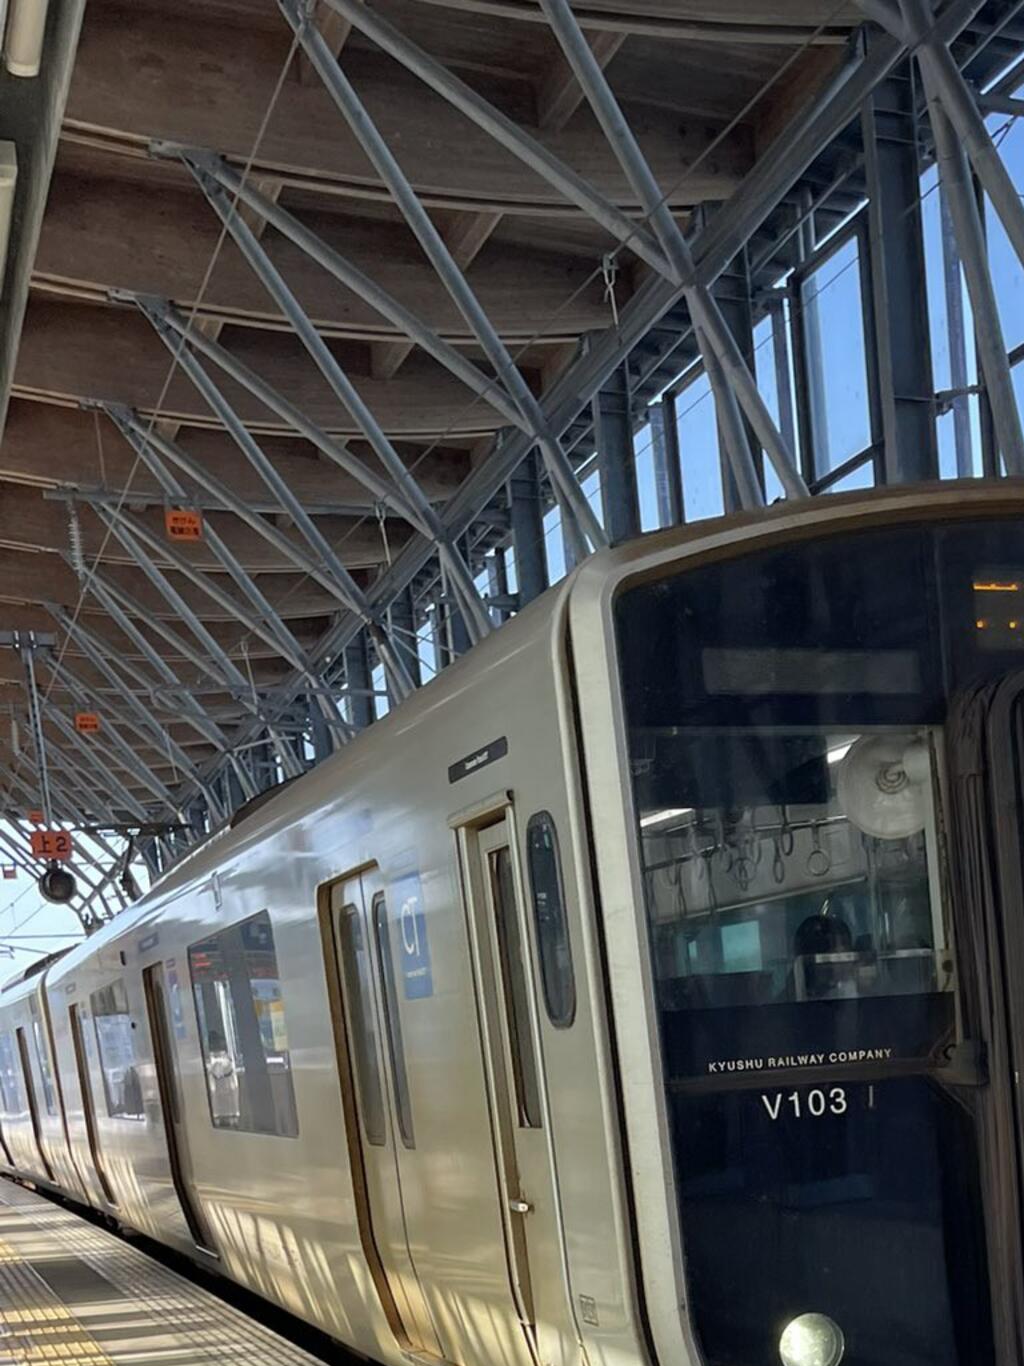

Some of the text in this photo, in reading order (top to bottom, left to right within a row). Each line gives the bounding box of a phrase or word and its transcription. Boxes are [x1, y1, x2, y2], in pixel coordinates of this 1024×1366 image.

[708, 1048, 893, 1073] KYUSHU RAILWAY COMPANY
[761, 1087, 848, 1121] V103
